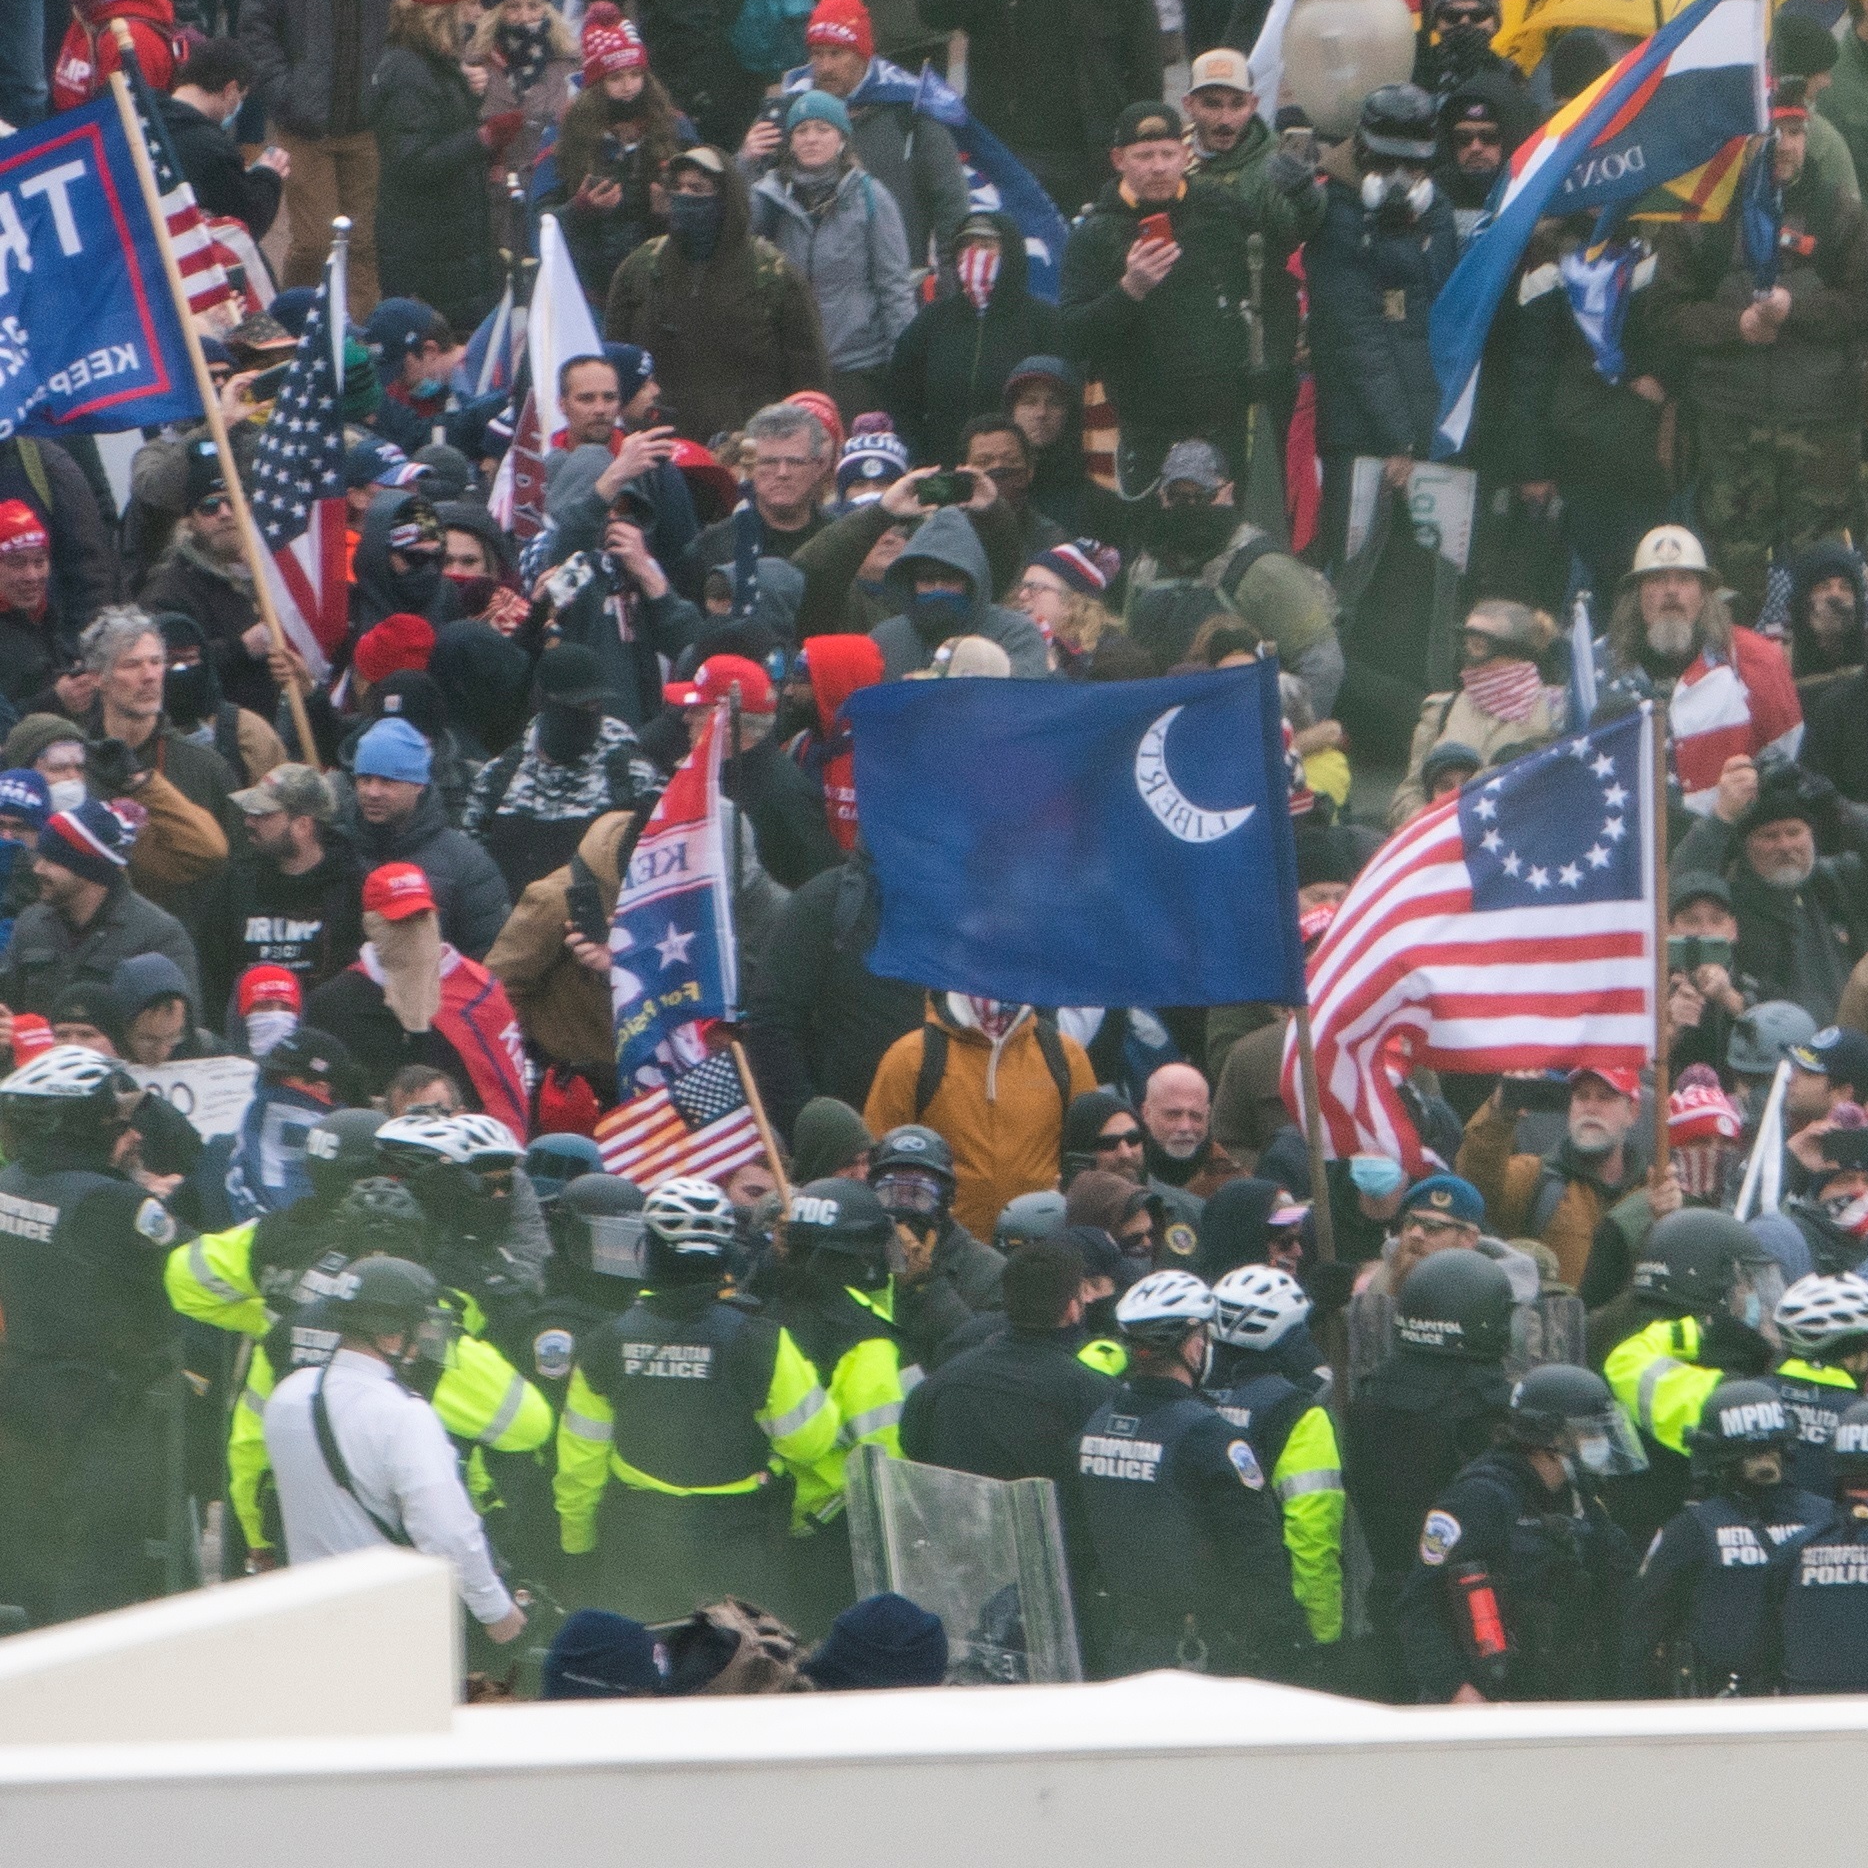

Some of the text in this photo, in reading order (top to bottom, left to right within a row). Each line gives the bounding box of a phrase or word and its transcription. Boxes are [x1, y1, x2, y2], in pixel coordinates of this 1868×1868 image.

[791, 1195, 839, 1226] PDC
[1720, 1400, 1784, 1438] MPDC
[1080, 1453, 1155, 1482] POLICE
